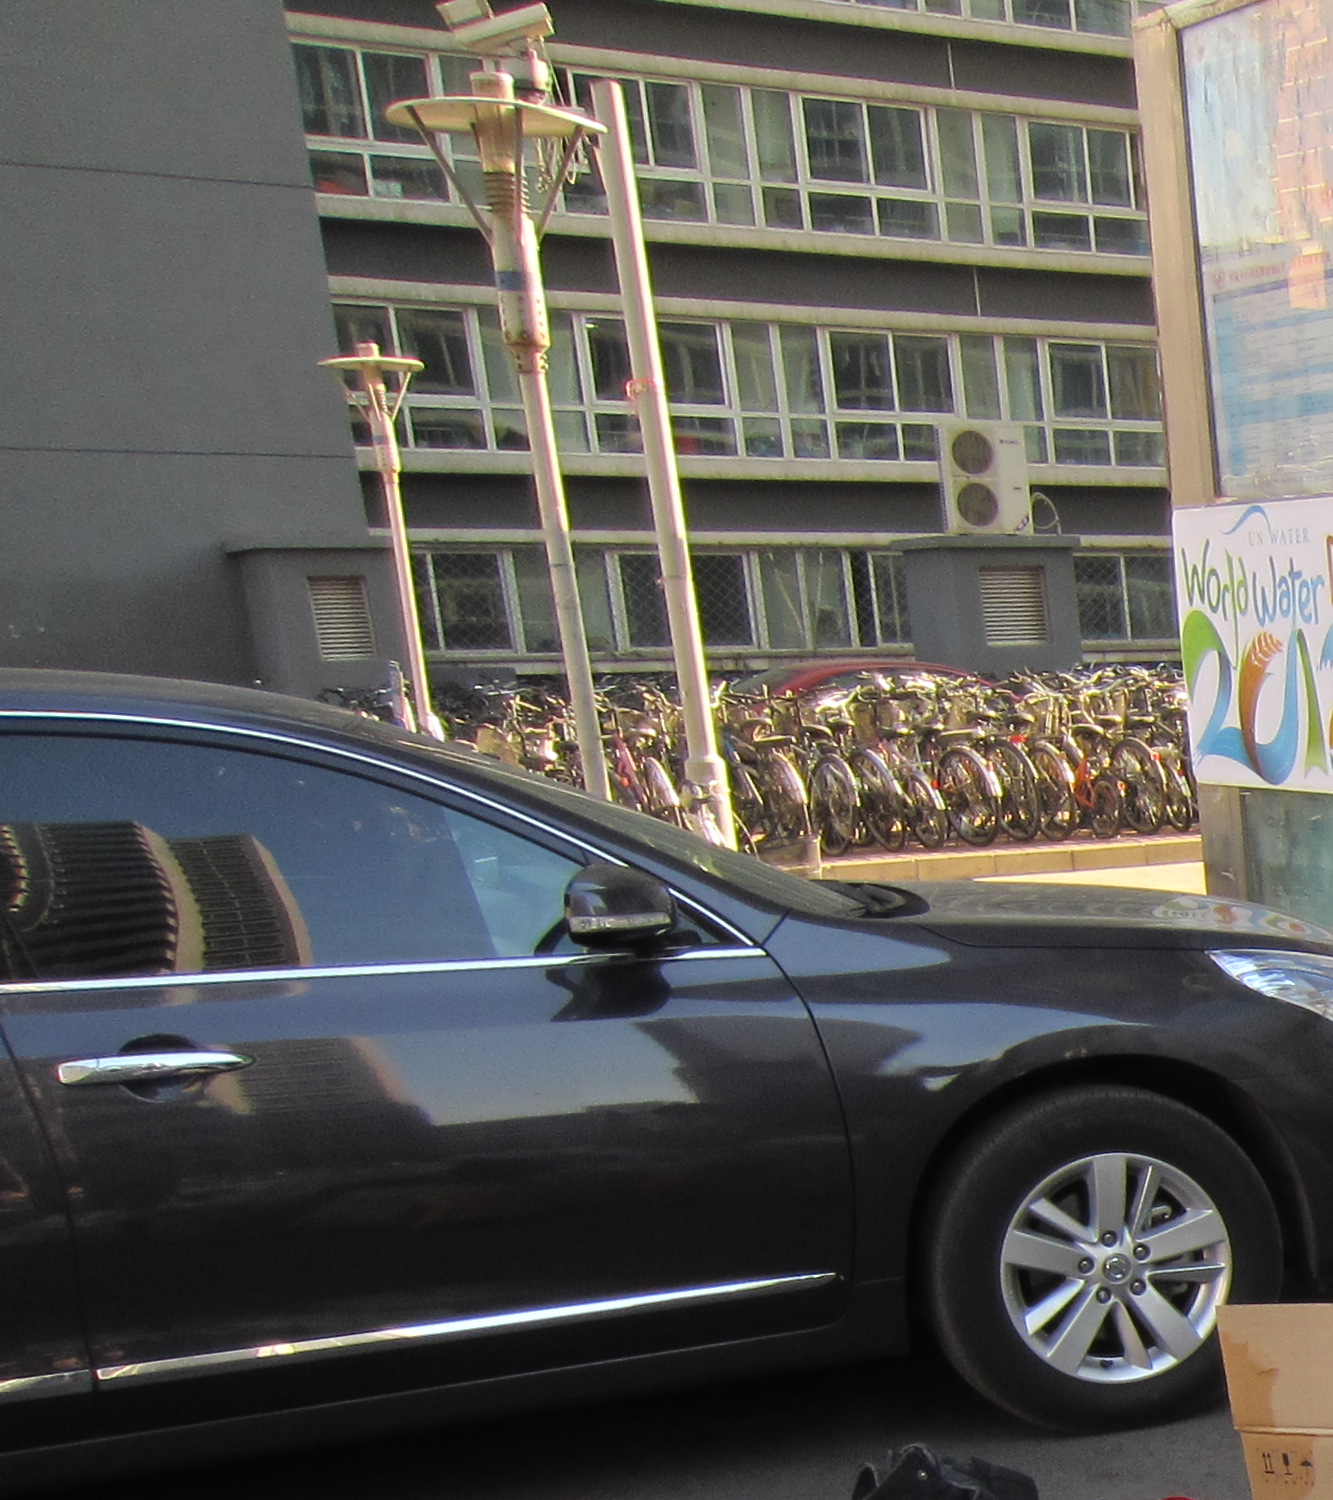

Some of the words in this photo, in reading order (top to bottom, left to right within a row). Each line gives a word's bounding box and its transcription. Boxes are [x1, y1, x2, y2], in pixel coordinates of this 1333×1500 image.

[1248, 531, 1263, 546] UN
[1268, 527, 1310, 545] WATER
[1181, 538, 1248, 669] World
[1252, 556, 1324, 627] Water
